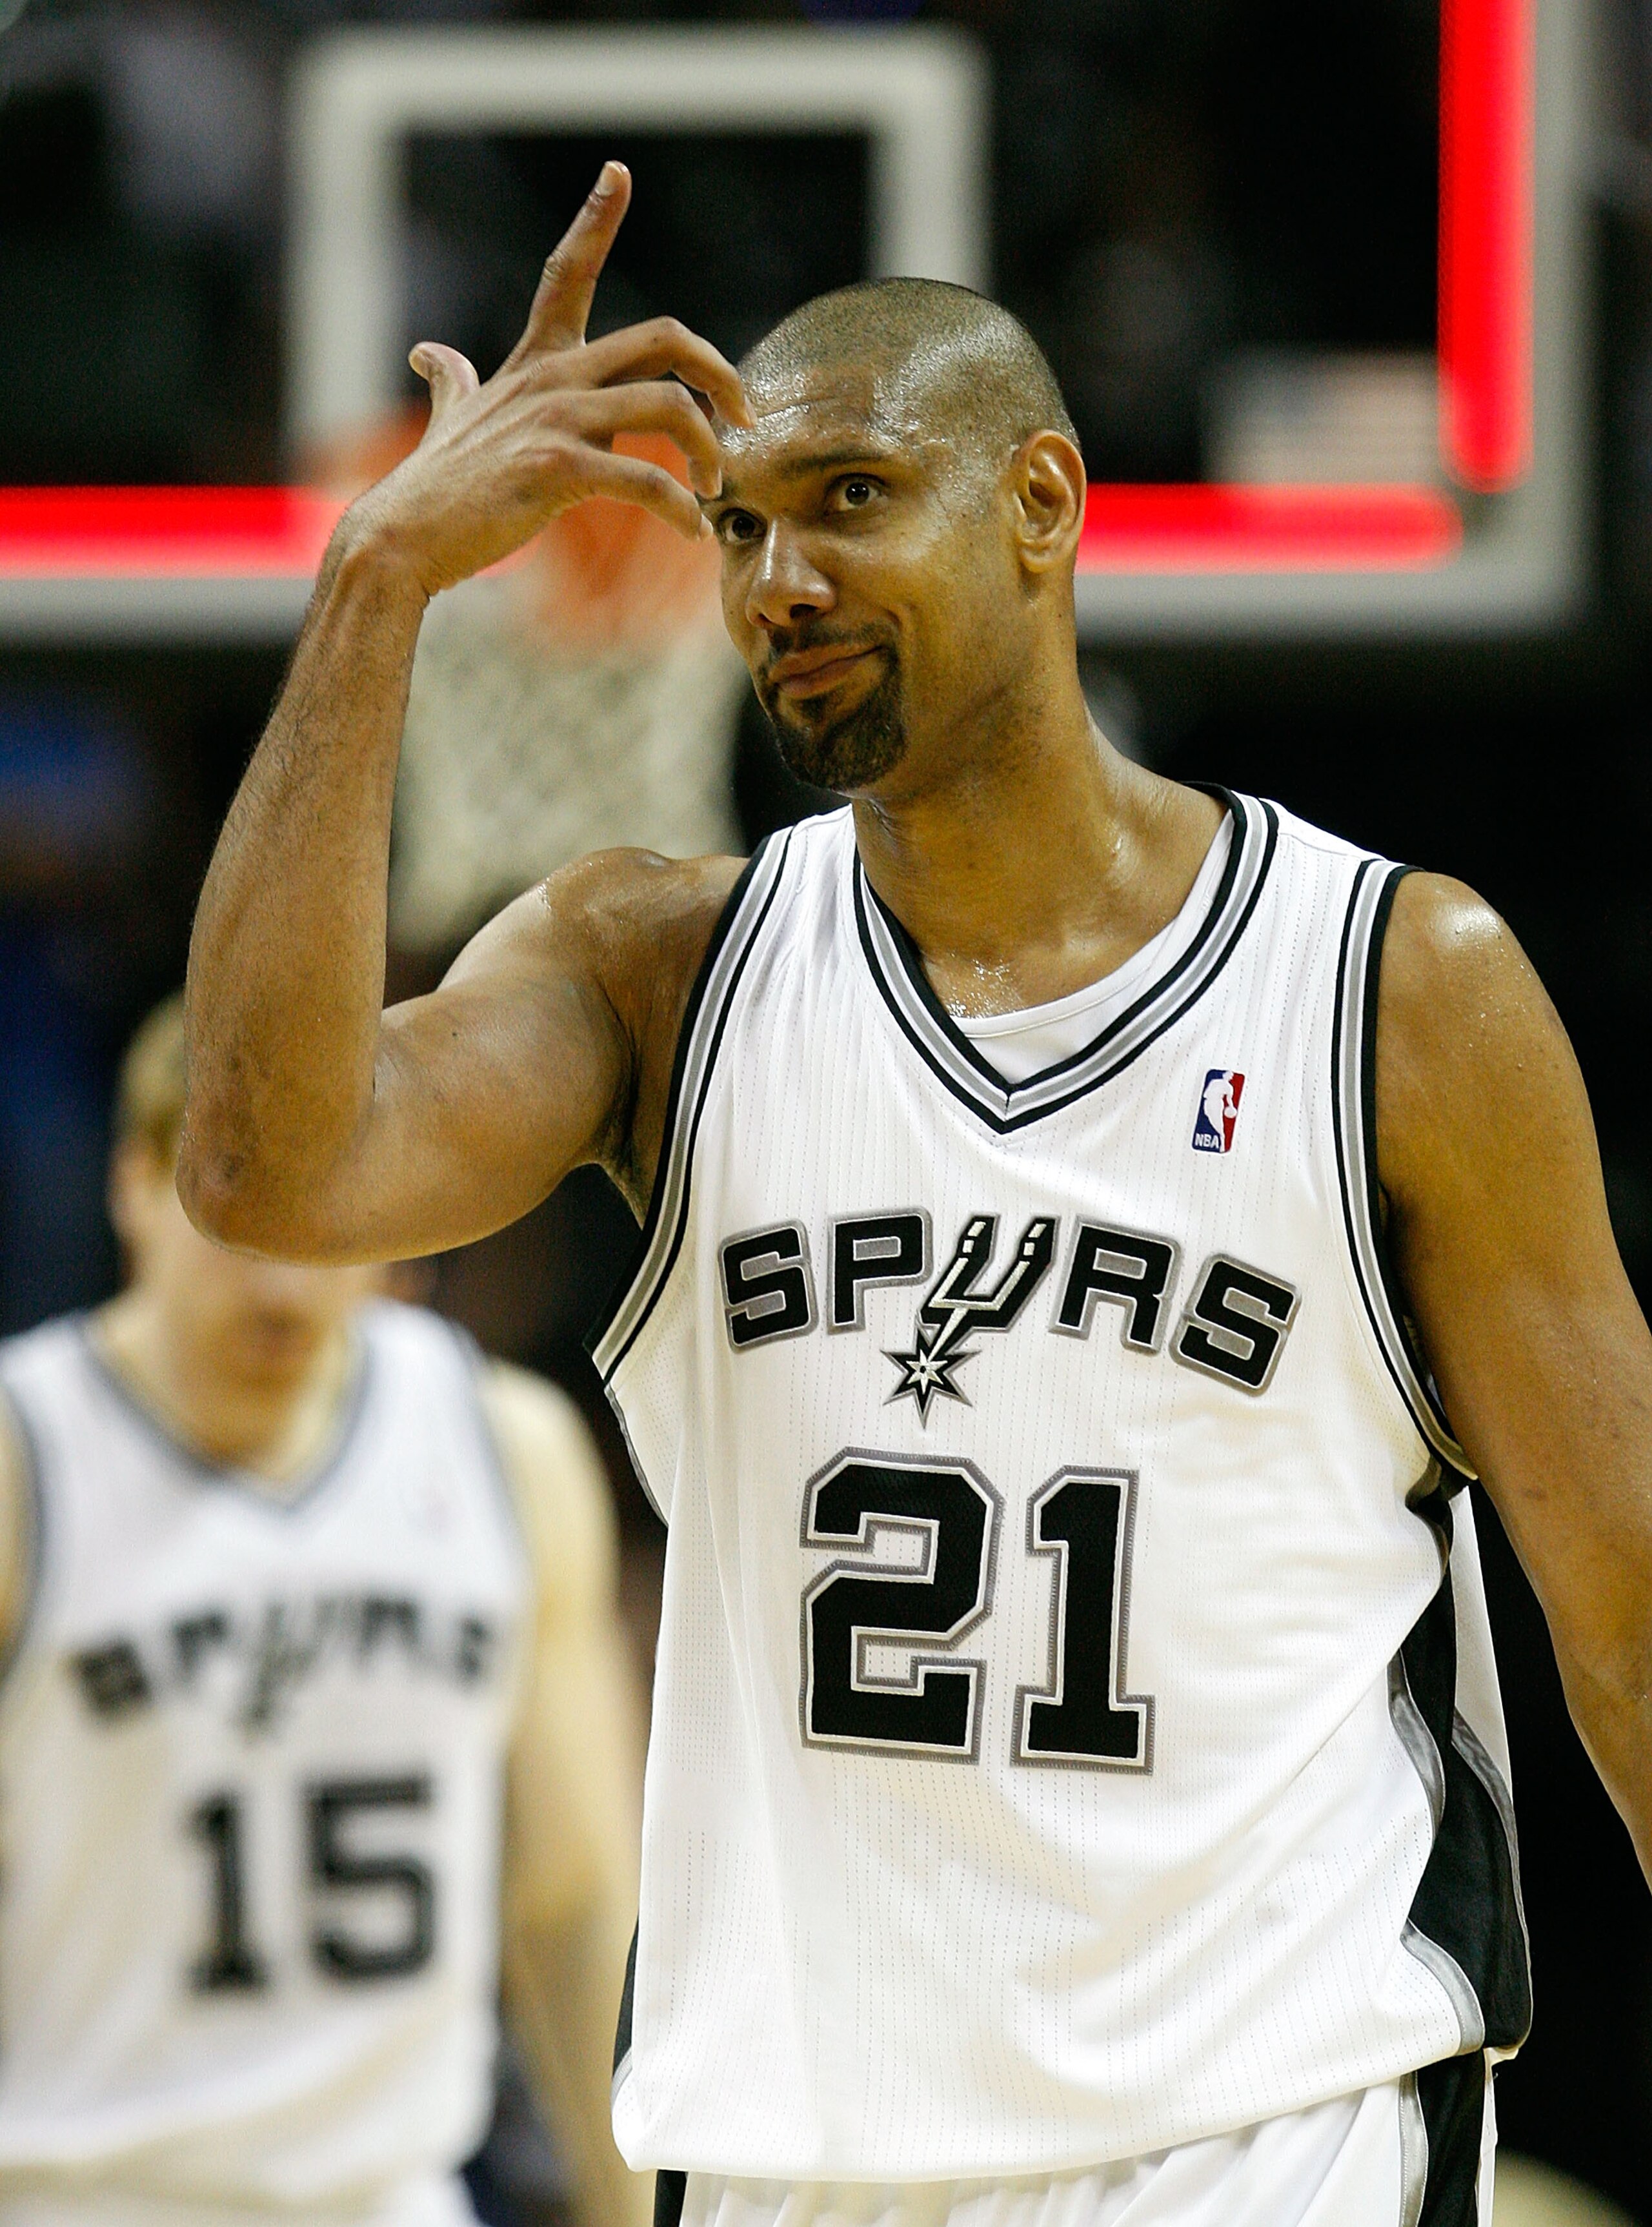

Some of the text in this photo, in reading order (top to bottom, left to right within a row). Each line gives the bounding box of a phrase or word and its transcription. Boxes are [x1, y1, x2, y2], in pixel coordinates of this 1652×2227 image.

[1195, 1134, 1219, 1148] NBA
[719, 1207, 1300, 1396] SPURS
[800, 1447, 1155, 1775] 21
[185, 1774, 435, 1993] 15
